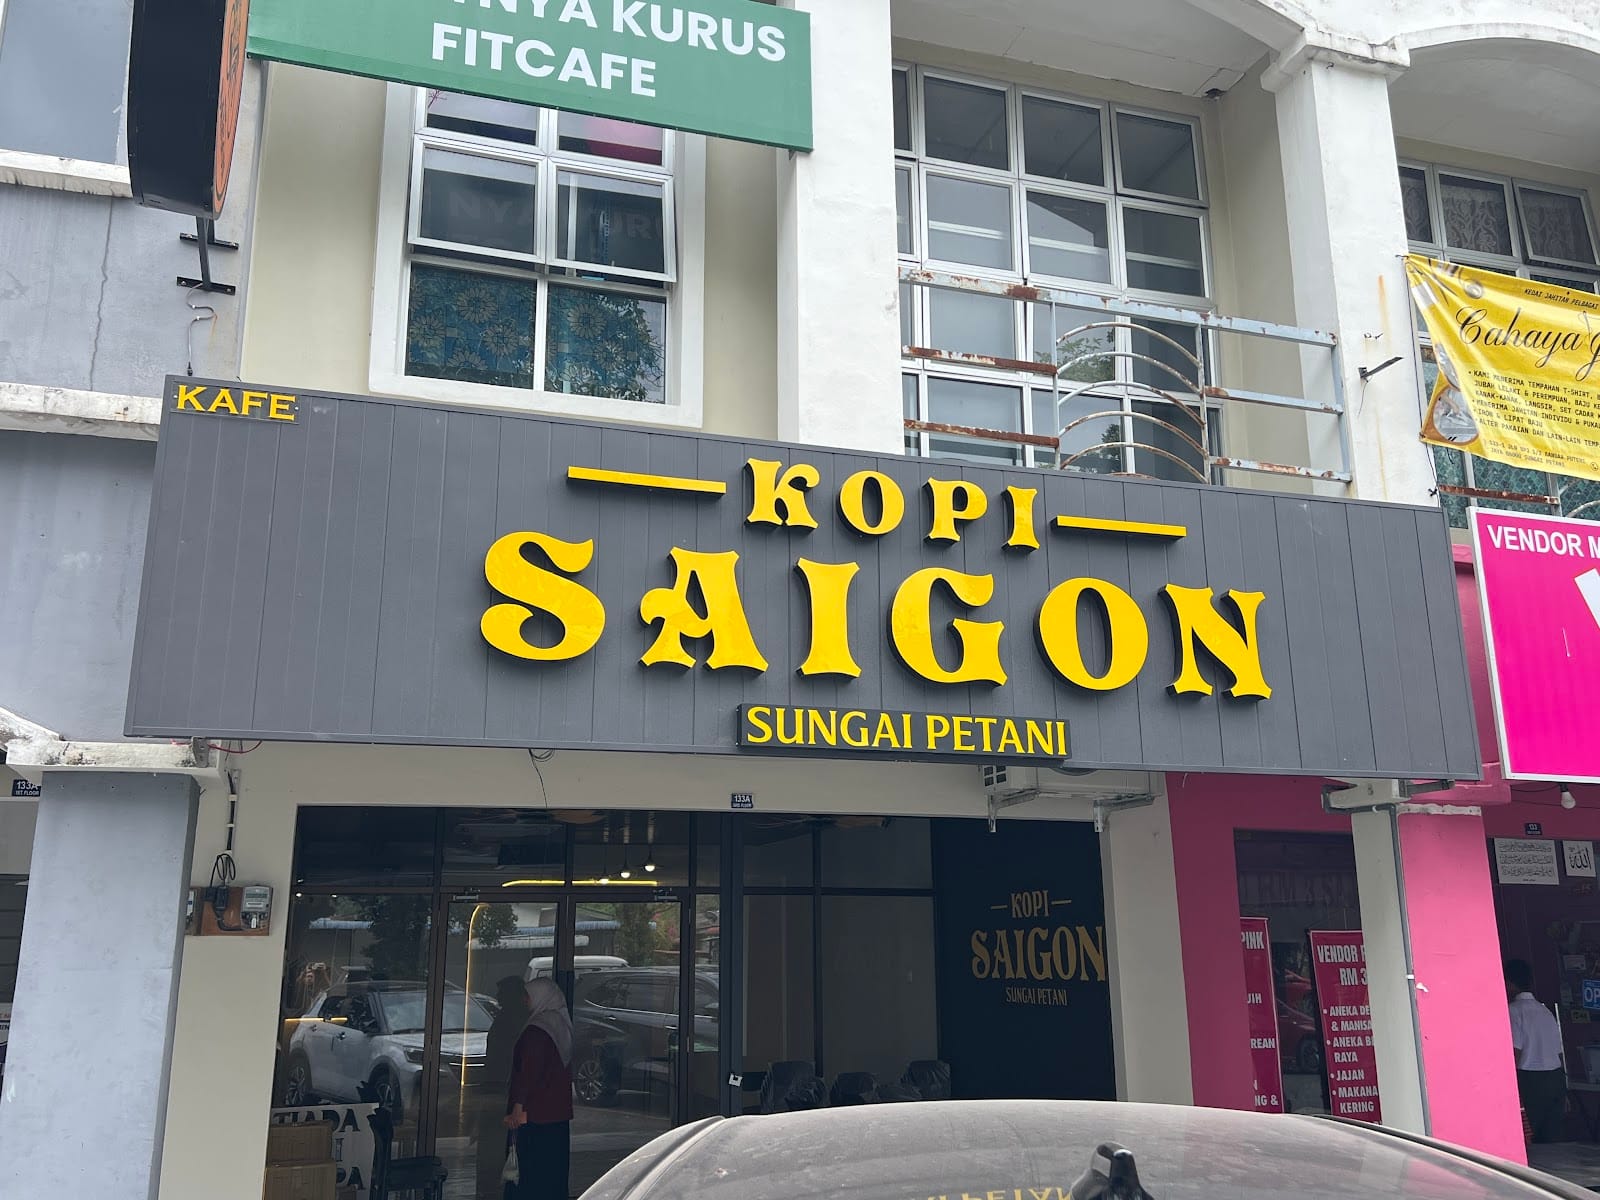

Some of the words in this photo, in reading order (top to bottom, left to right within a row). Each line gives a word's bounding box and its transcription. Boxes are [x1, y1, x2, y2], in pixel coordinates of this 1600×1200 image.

[613, 0, 786, 61] KURUS
[432, 23, 656, 97] FITCAFE
[1456, 307, 1580, 368] Cahaya
[1528, 381, 1559, 392] TEMPAHAN
[177, 384, 296, 421] KAFE
[1560, 406, 1571, 414] SET
[1504, 414, 1524, 423] LIPAT
[1541, 413, 1572, 424] INDIVIDU
[1584, 440, 1600, 449] TEMP
[746, 458, 1040, 549] KOPI
[1487, 525, 1584, 557] VENDOR
[481, 531, 1272, 699] SAIGON
[747, 706, 912, 750] SUNGAI
[926, 714, 1068, 755] PETANI
[1011, 889, 1049, 918] KOPI
[971, 926, 1106, 981] SAIGON
[1317, 945, 1358, 963] VENDOR
[1340, 968, 1358, 986] RM
[1006, 987, 1036, 1004] SUNGAI
[1037, 988, 1067, 1006] PETANI
[1330, 1005, 1358, 1017] ANEKA
[1332, 1021, 1338, 1032] &
[1251, 1038, 1275, 1049] REAN
[1333, 1036, 1363, 1048] ANEKA
[1334, 1052, 1358, 1063] RAYA
[1336, 1070, 1364, 1081] JAJAN
[1339, 1086, 1378, 1098] MAKANA
[1271, 1096, 1278, 1106] &
[1340, 1102, 1374, 1113] KERING
